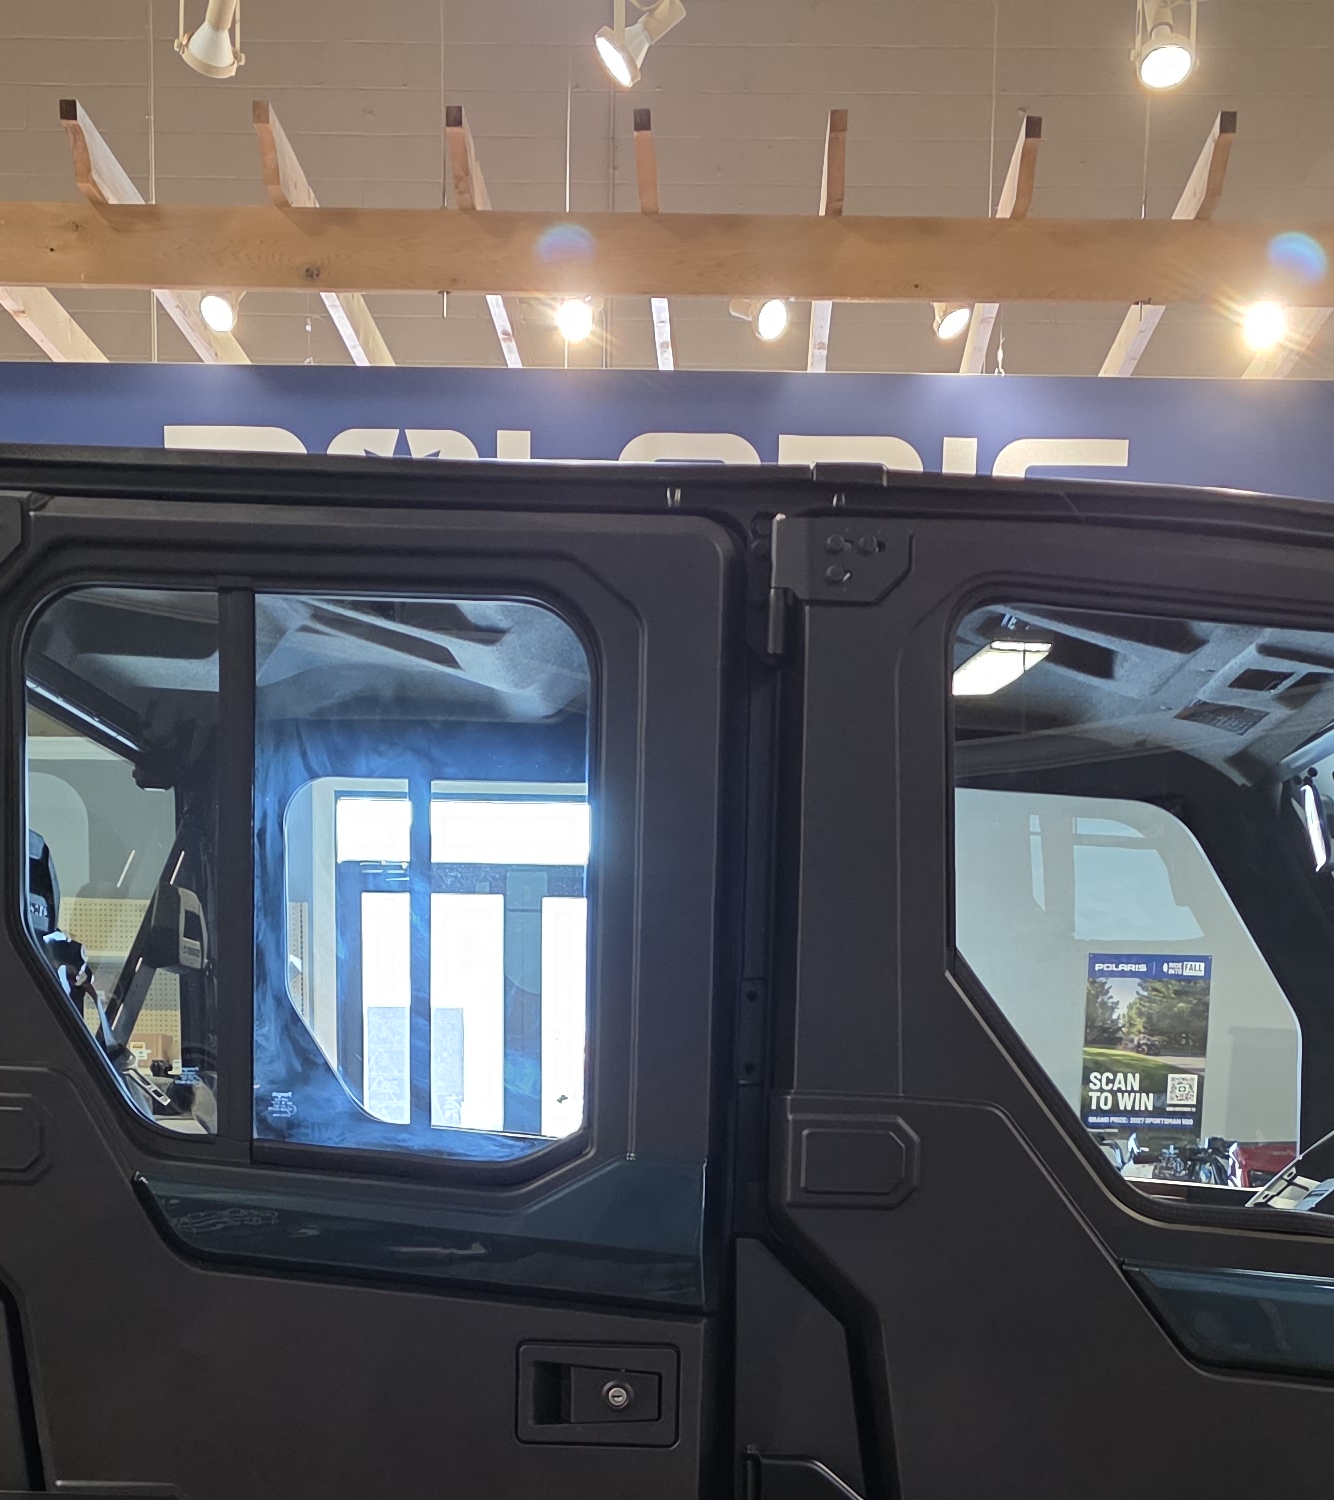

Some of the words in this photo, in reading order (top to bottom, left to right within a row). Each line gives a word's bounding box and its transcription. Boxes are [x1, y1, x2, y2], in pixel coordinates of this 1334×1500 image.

[1095, 964, 1147, 972] POLARIS
[1185, 963, 1203, 971] FALL
[1089, 1072, 1140, 1090] SCAN
[1088, 1092, 1112, 1110] TO
[1117, 1093, 1153, 1110] WIN
